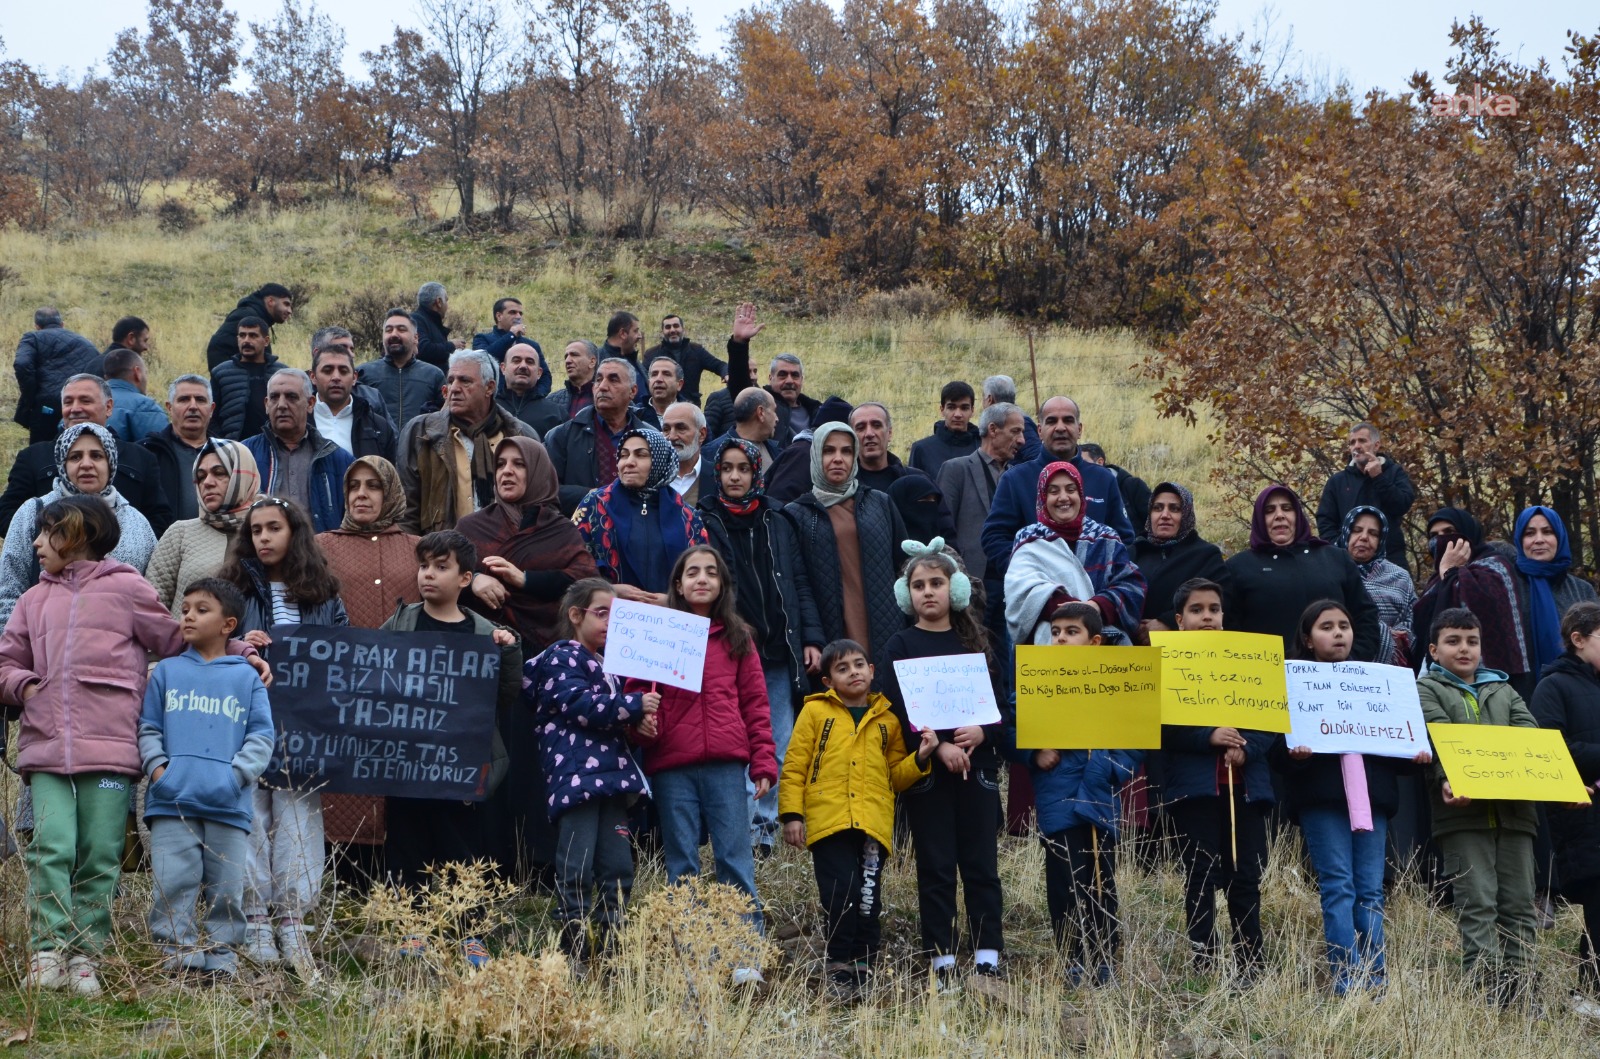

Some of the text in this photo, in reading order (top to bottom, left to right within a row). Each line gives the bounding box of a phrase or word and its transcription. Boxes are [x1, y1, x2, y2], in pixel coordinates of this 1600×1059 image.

[282, 637, 397, 669] TOPRAK
[897, 663, 918, 677] Bu
[275, 662, 310, 688] SA
[380, 669, 459, 705] NASIL
[1019, 684, 1035, 695] Bu
[1036, 684, 1054, 698] Köy
[1083, 683, 1097, 695] Bu
[1302, 681, 1332, 691] TALAN
[1297, 701, 1324, 713] RANT
